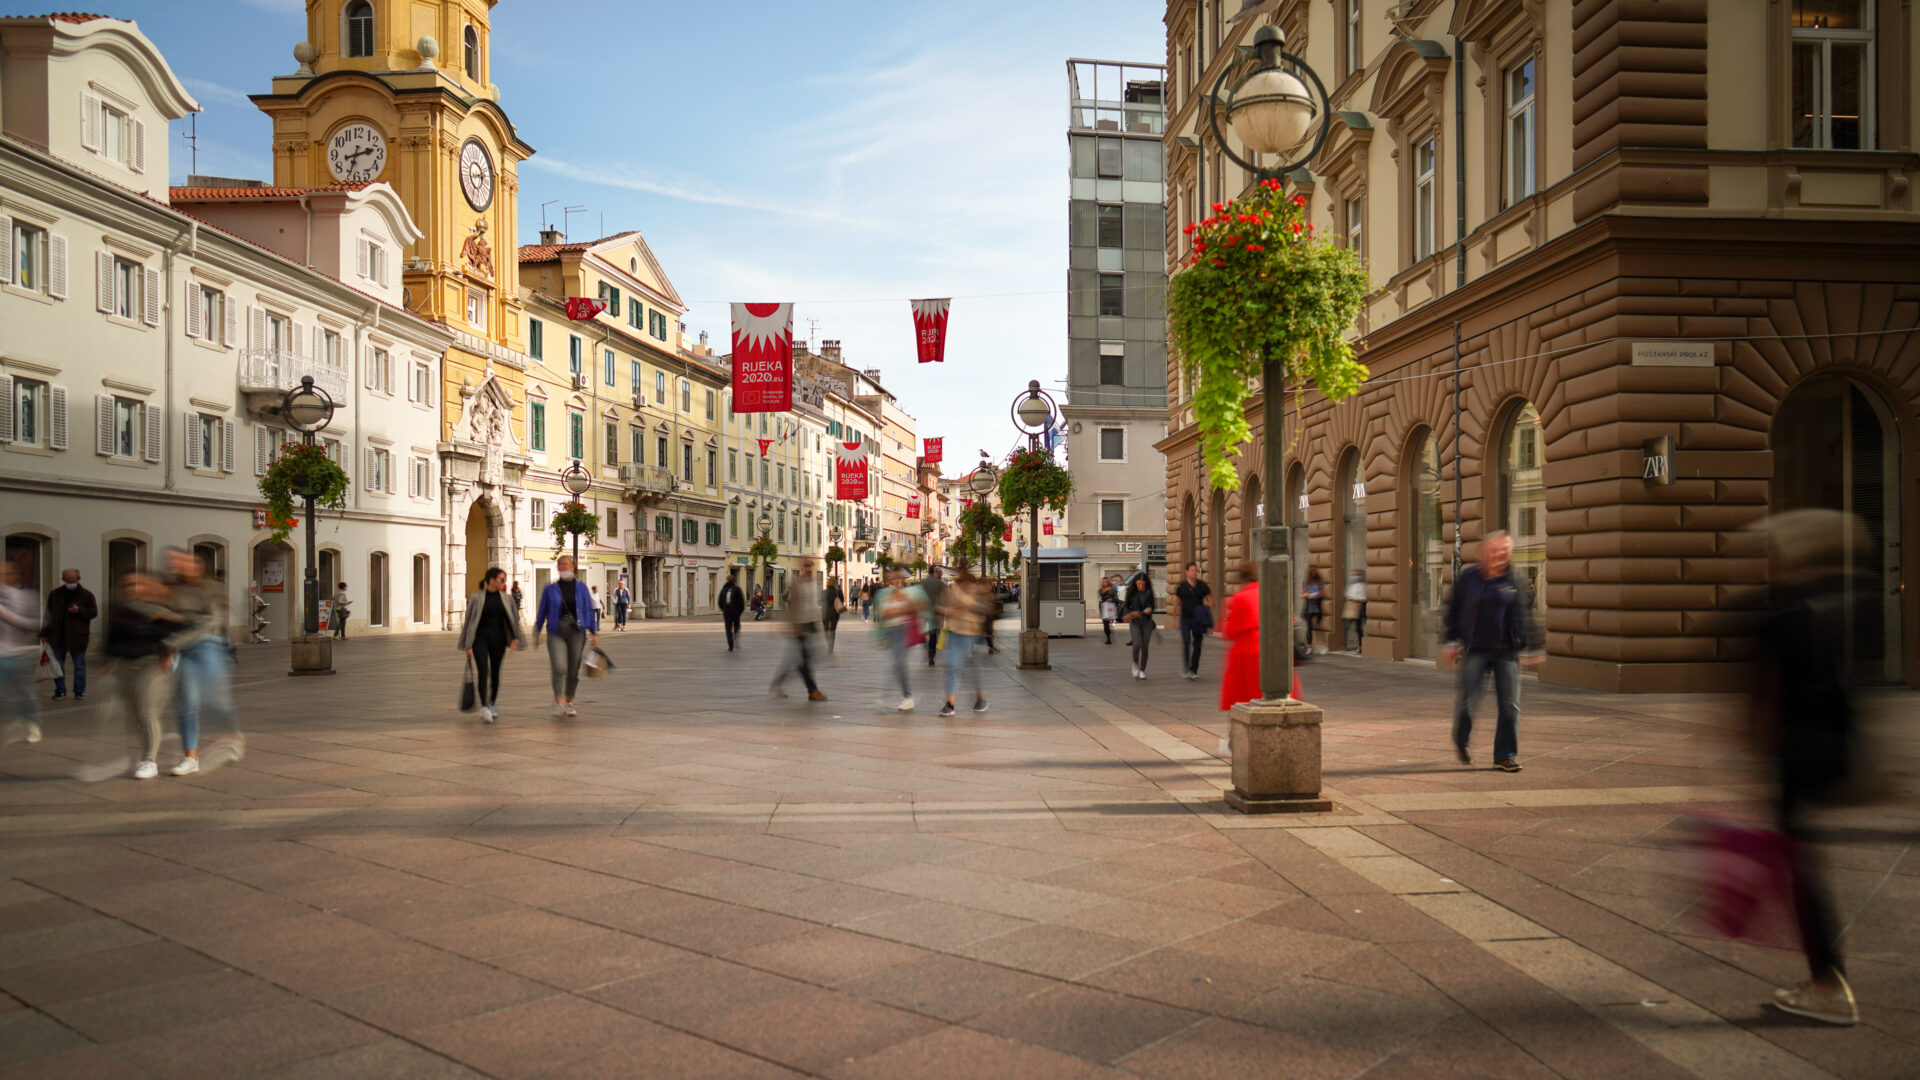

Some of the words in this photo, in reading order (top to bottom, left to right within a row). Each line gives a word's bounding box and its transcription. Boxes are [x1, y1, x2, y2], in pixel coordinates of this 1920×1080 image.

[344, 129, 351, 142] 11
[354, 127, 363, 139] 12
[367, 130, 371, 142] 1
[335, 136, 345, 148] 10
[372, 136, 379, 148] 2
[331, 149, 338, 161] 9
[376, 147, 384, 160] 3
[335, 161, 343, 174] 8
[371, 159, 379, 171] 4
[353, 171, 361, 182] 6
[363, 169, 371, 182] 5
[1637, 350, 1677, 358] POŠTANSKI
[742, 361, 784, 372] RIJEKA
[742, 372, 784, 384] 2020.eu
